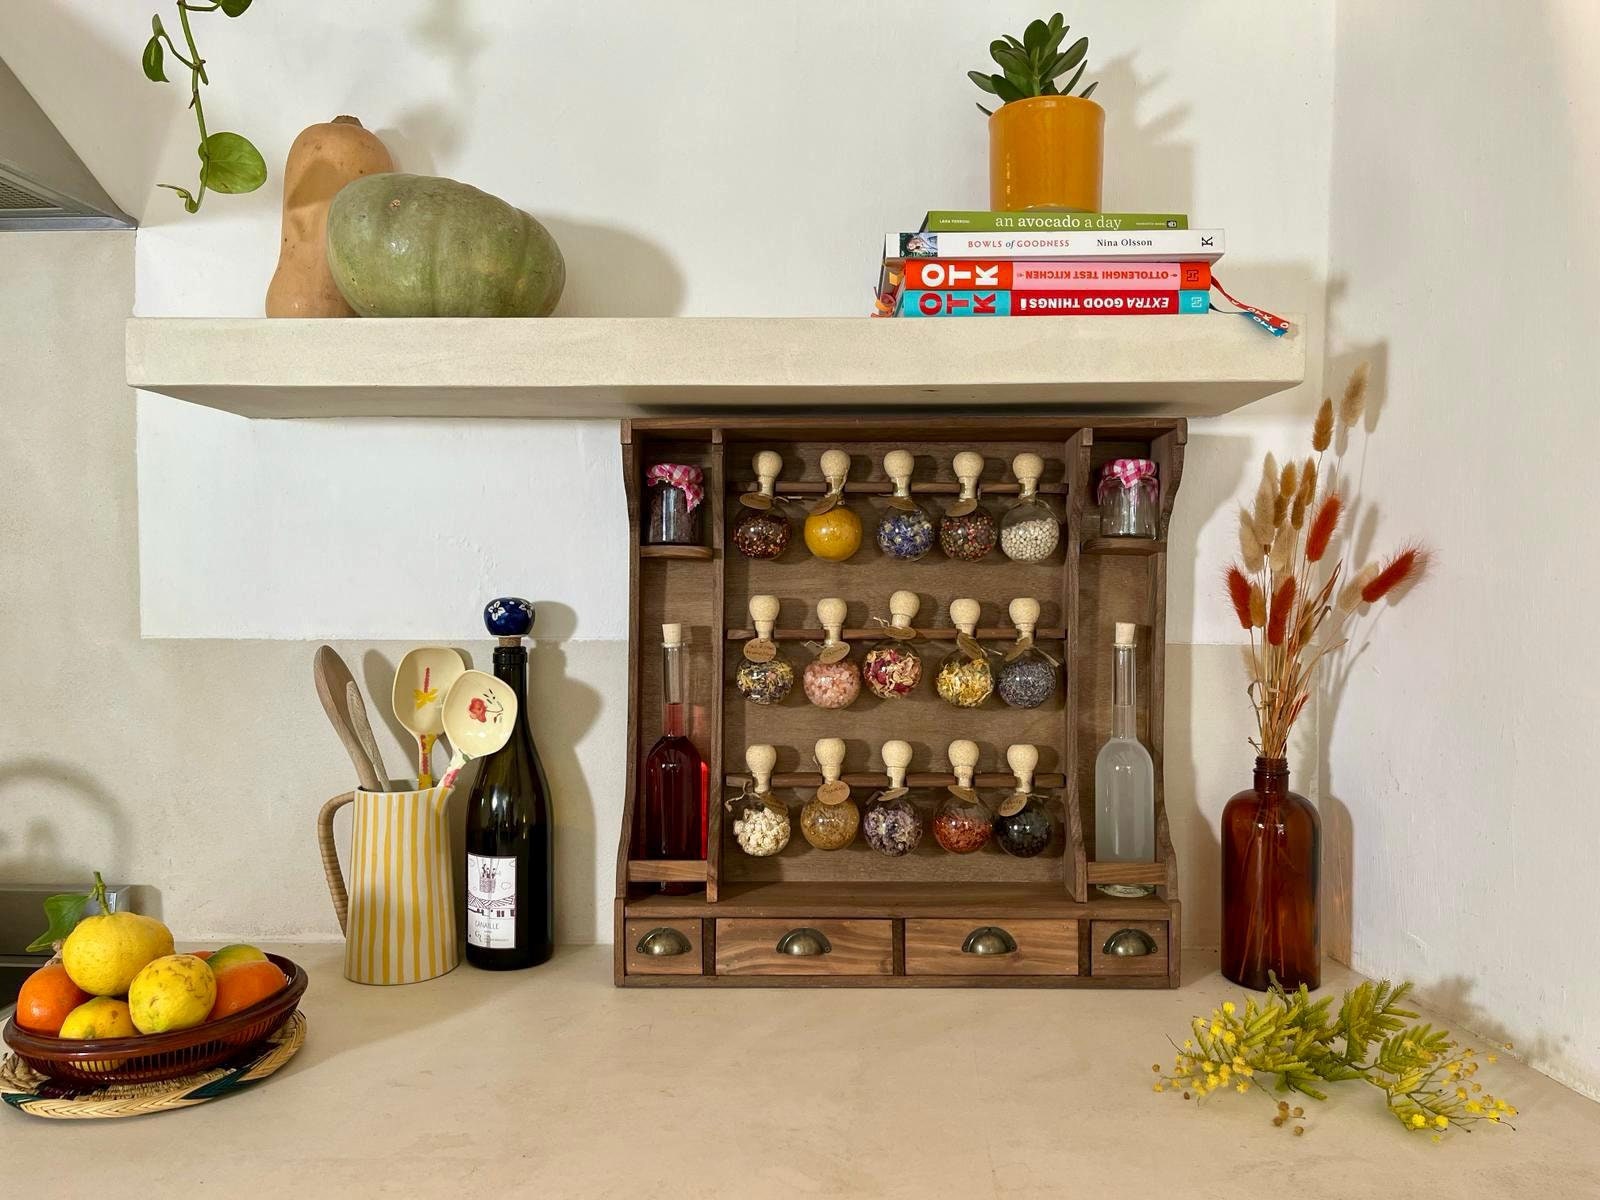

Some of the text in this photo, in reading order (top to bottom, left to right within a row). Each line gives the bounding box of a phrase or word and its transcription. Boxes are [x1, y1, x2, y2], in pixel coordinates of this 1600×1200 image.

[995, 216, 1013, 227] an
[1018, 215, 1080, 228] avocado
[1084, 218, 1093, 228] a
[1096, 216, 1122, 230] day
[967, 239, 1070, 249] BOWLS of GOODNESS
[1097, 238, 1153, 247] Nina Olsson
[1025, 270, 1169, 279] OTTOLENGHI TEST KITCHEN
[1029, 297, 1169, 309] EXTRA GOOD THINGS
